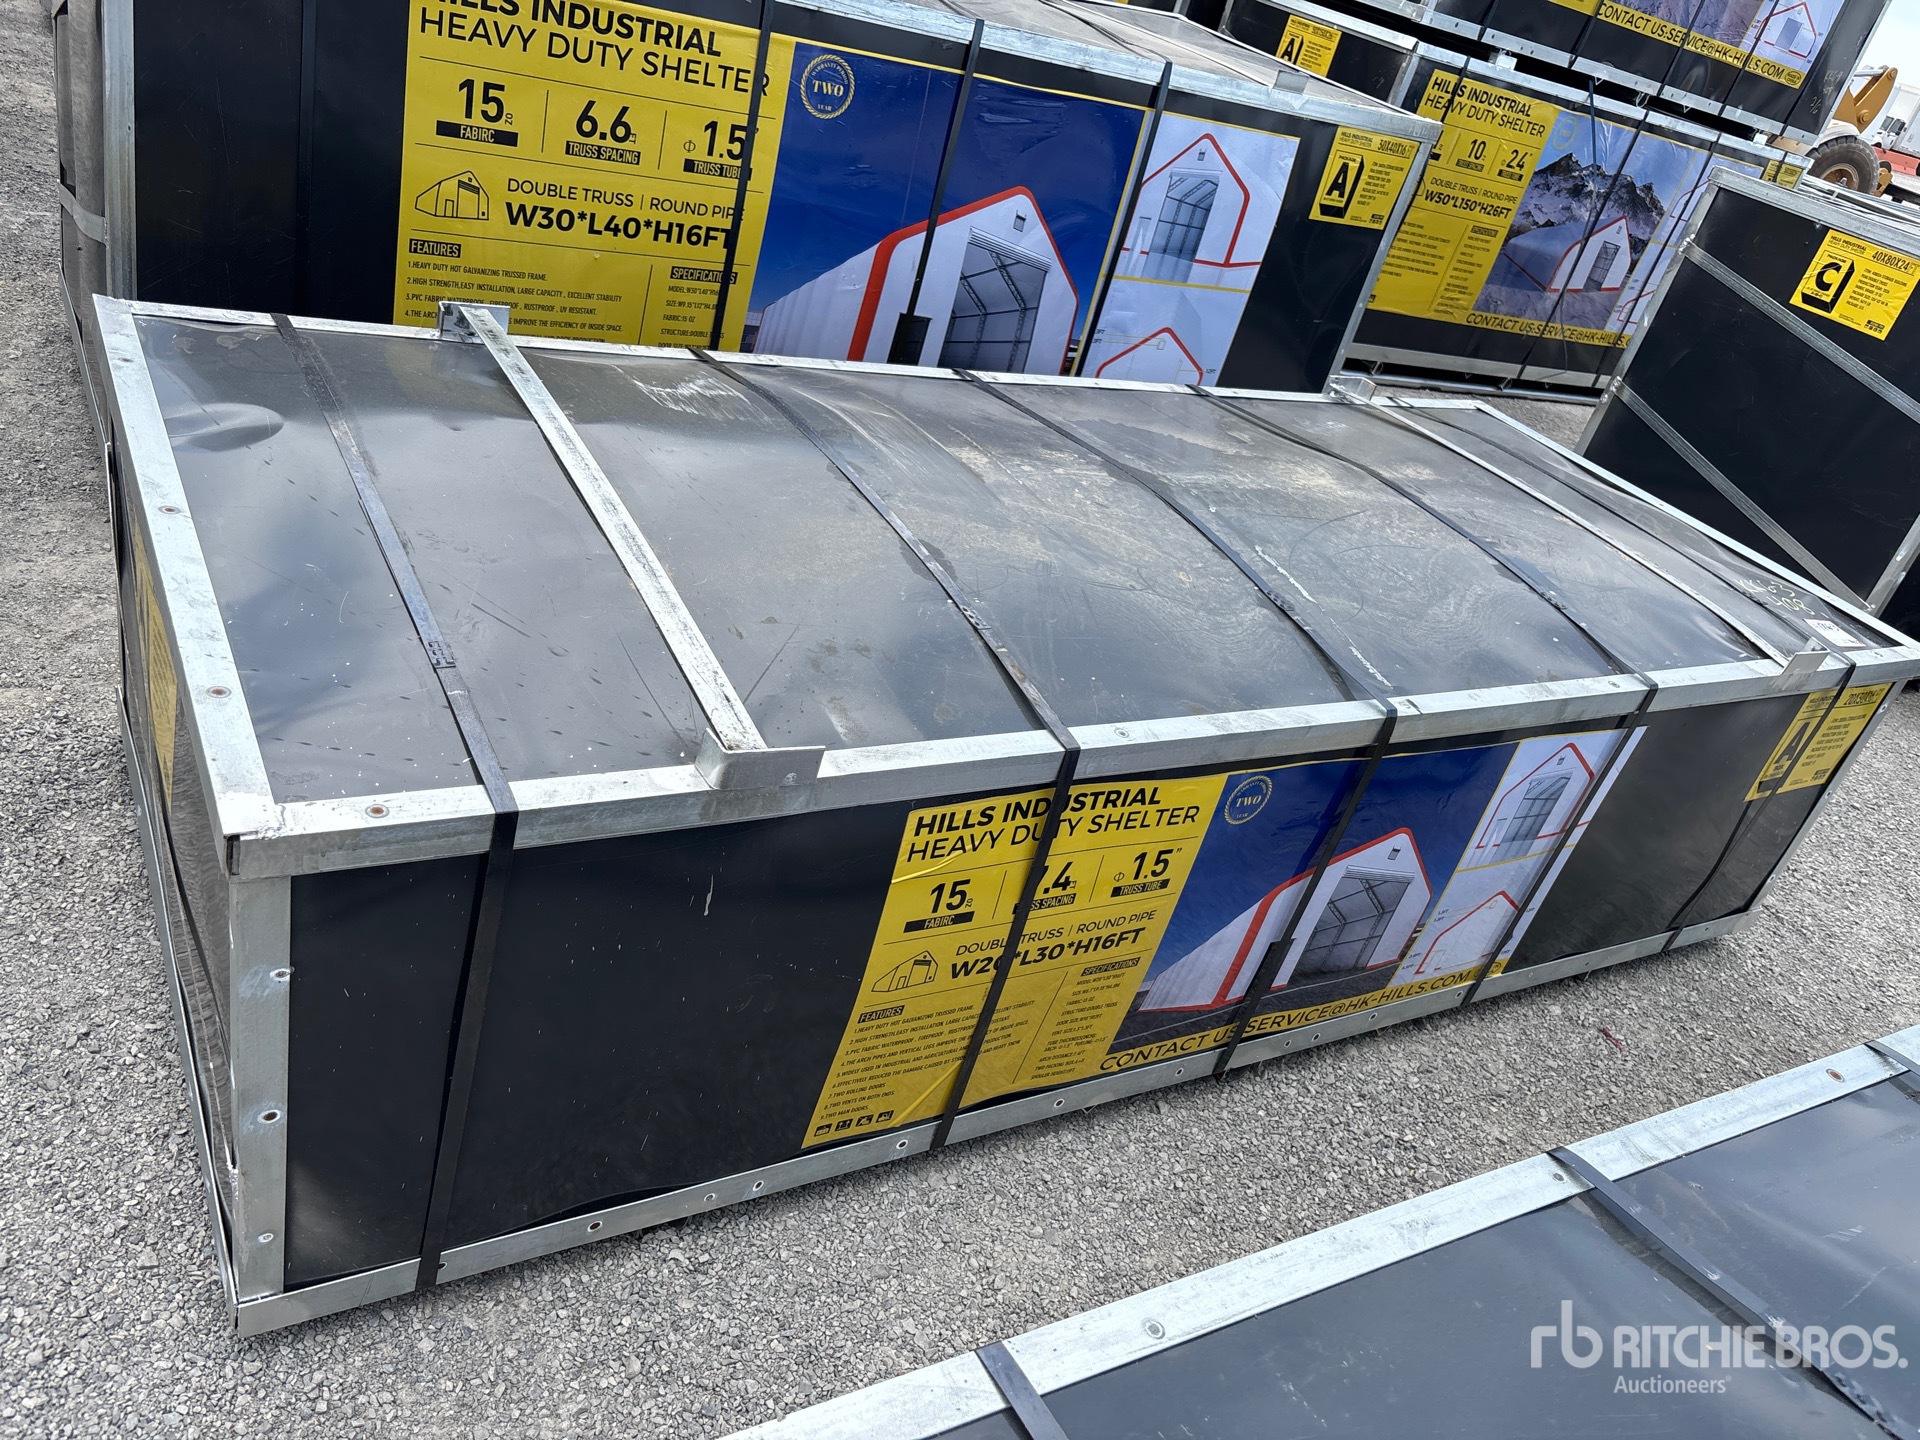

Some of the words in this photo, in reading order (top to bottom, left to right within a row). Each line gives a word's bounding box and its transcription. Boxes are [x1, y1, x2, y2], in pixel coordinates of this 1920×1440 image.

[421, 7, 537, 52] HEAVY
[547, 32, 634, 71] DUTY
[531, 0, 721, 57] INDUSTRIAL
[1281, 38, 1296, 62] A
[812, 79, 845, 97] TWO
[458, 78, 506, 123] 15
[1467, 87, 1532, 117] INDUSTRIAL
[576, 100, 632, 143] 6.6
[1466, 105, 1499, 124] DUTY
[1498, 114, 1546, 138] SHELTER
[459, 125, 496, 143] FABIRC
[568, 142, 598, 158] TRUSS
[600, 147, 638, 164] SPACING
[1468, 139, 1486, 160] 10
[693, 161, 720, 175] TRUSS
[1325, 162, 1350, 198] A
[1430, 177, 1458, 191] DOUBLE
[1458, 183, 1478, 195] TRUSS
[1482, 189, 1504, 201] ROUND
[1504, 194, 1518, 204] PIPE
[507, 178, 578, 200] DOUBLE
[582, 188, 634, 208] TRUSS
[650, 197, 708, 217] ROUND
[411, 240, 460, 257] FEATURES
[432, 263, 448, 271] DUTY
[450, 264, 462, 272] HOT
[463, 265, 500, 277] GALVANIZING
[501, 269, 526, 280] TRUSSED
[672, 267, 736, 284] SPECIFICATIS
[1815, 262, 1843, 292] C
[517, 287, 535, 296] LARGE
[536, 289, 563, 298] CAPACITY
[567, 291, 596, 301] EXCELLENT
[596, 293, 622, 303] STABILITY
[523, 303, 556, 312] RUSTPROOF
[513, 318, 537, 327] IMPROVE
[549, 320, 578, 329] EFFICIENCY
[588, 323, 605, 331] INSIDE
[1466, 313, 1519, 331] CONTACT
[1773, 722, 1810, 764] A
[1236, 795, 1262, 808] TWO
[914, 806, 997, 837] HILLS
[907, 828, 1006, 862] HEAVY
[1087, 805, 1200, 834] SHELTER
[929, 878, 971, 914] 15
[1119, 884, 1143, 896] TRUSS
[1143, 880, 1162, 891] TUBE
[1041, 894, 1074, 908] SPACING
[924, 915, 955, 929] FABIRC
[955, 938, 1007, 956] DOUBL
[1020, 927, 1065, 944] TRUSS
[1076, 916, 1126, 935] ROUND
[1128, 909, 1157, 925] PIPE
[1083, 958, 1139, 976] SPECIFICATIONS
[860, 1006, 903, 1023] FEATURES
[1100, 1034, 1210, 1071] CONTACT
